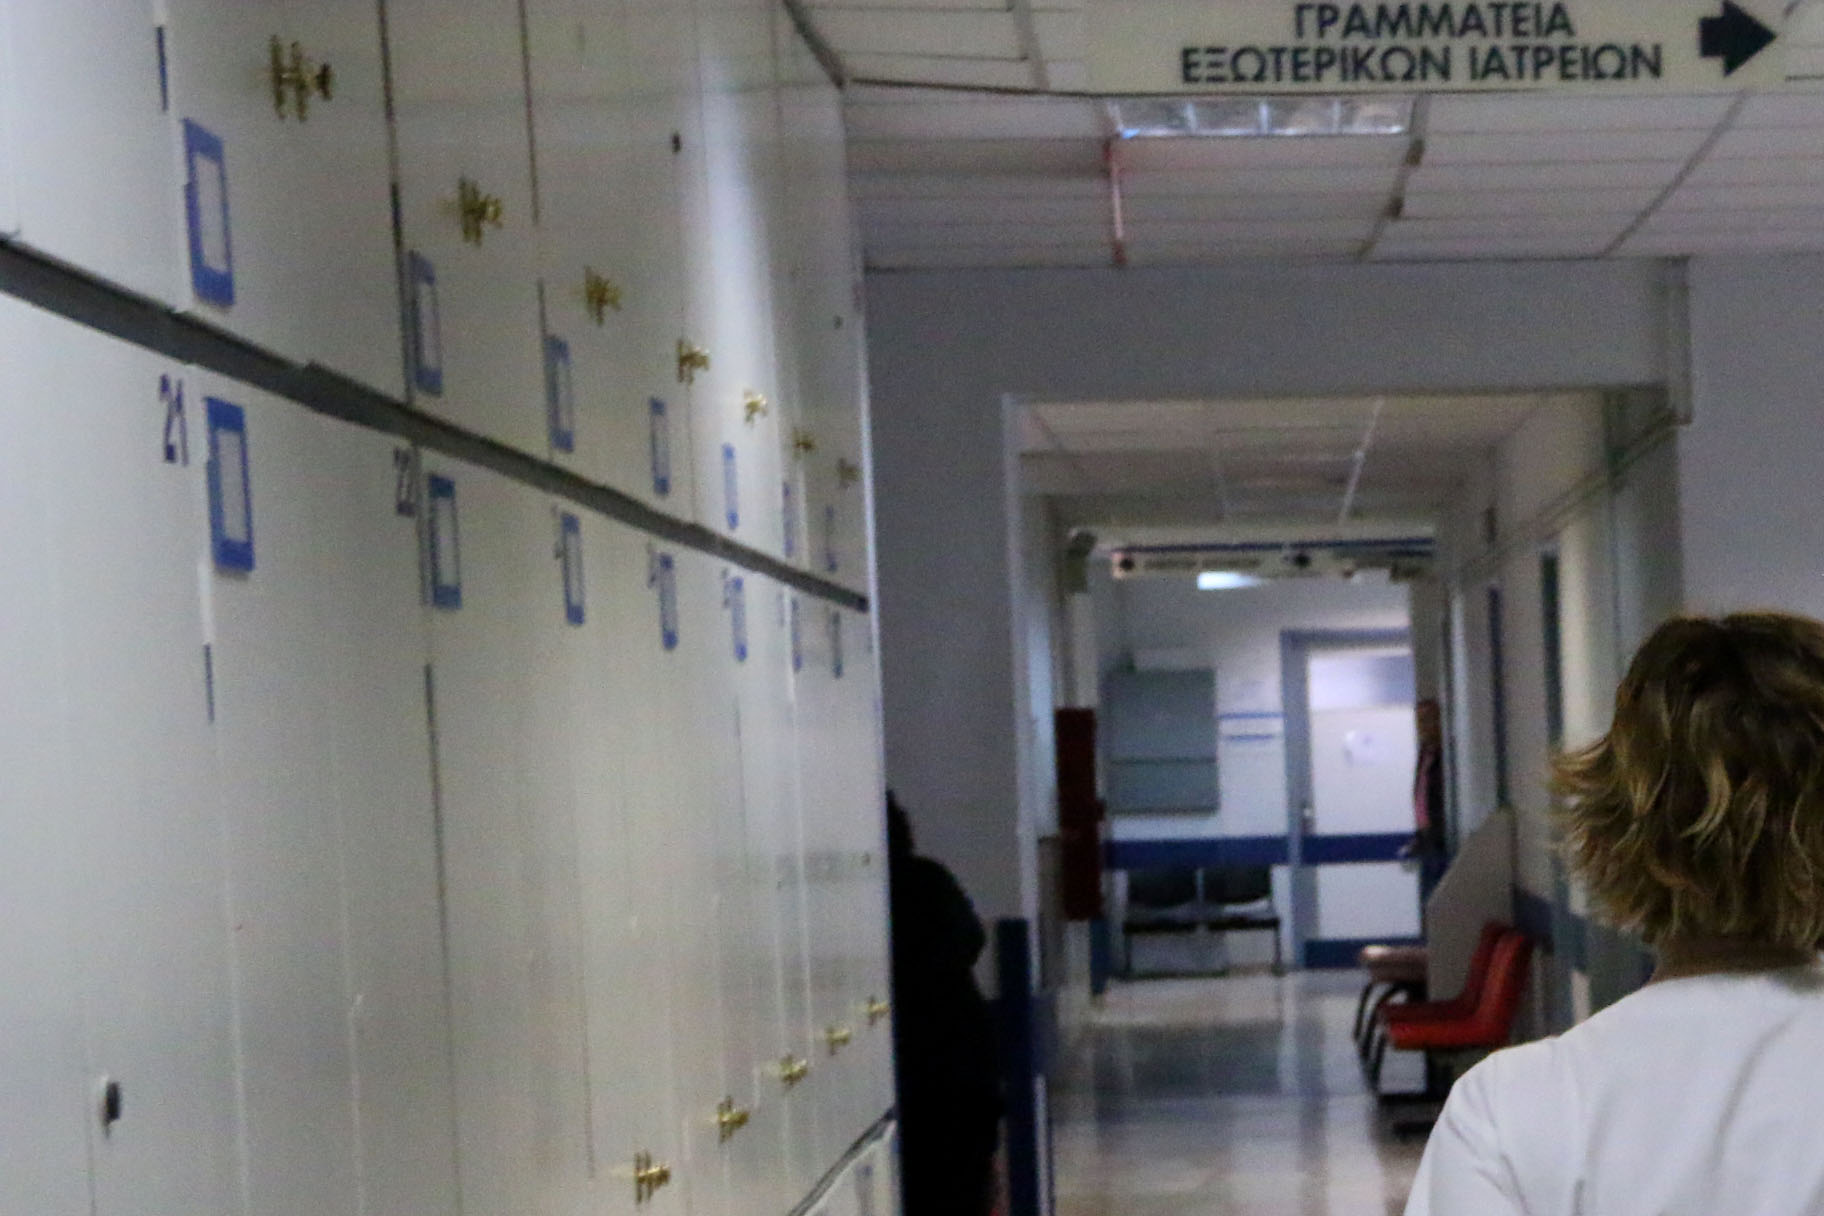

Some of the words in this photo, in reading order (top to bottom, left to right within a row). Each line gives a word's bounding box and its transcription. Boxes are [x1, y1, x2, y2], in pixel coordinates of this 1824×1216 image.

[1295, 3, 1575, 39] ΓΡΑΜΜΑΤΕΙΑ
[1181, 46, 1451, 83] ΕΞΩΤΕΡΙΚΩΝ
[1468, 43, 1663, 81] ΙΑΤΡΕΙΩΝ
